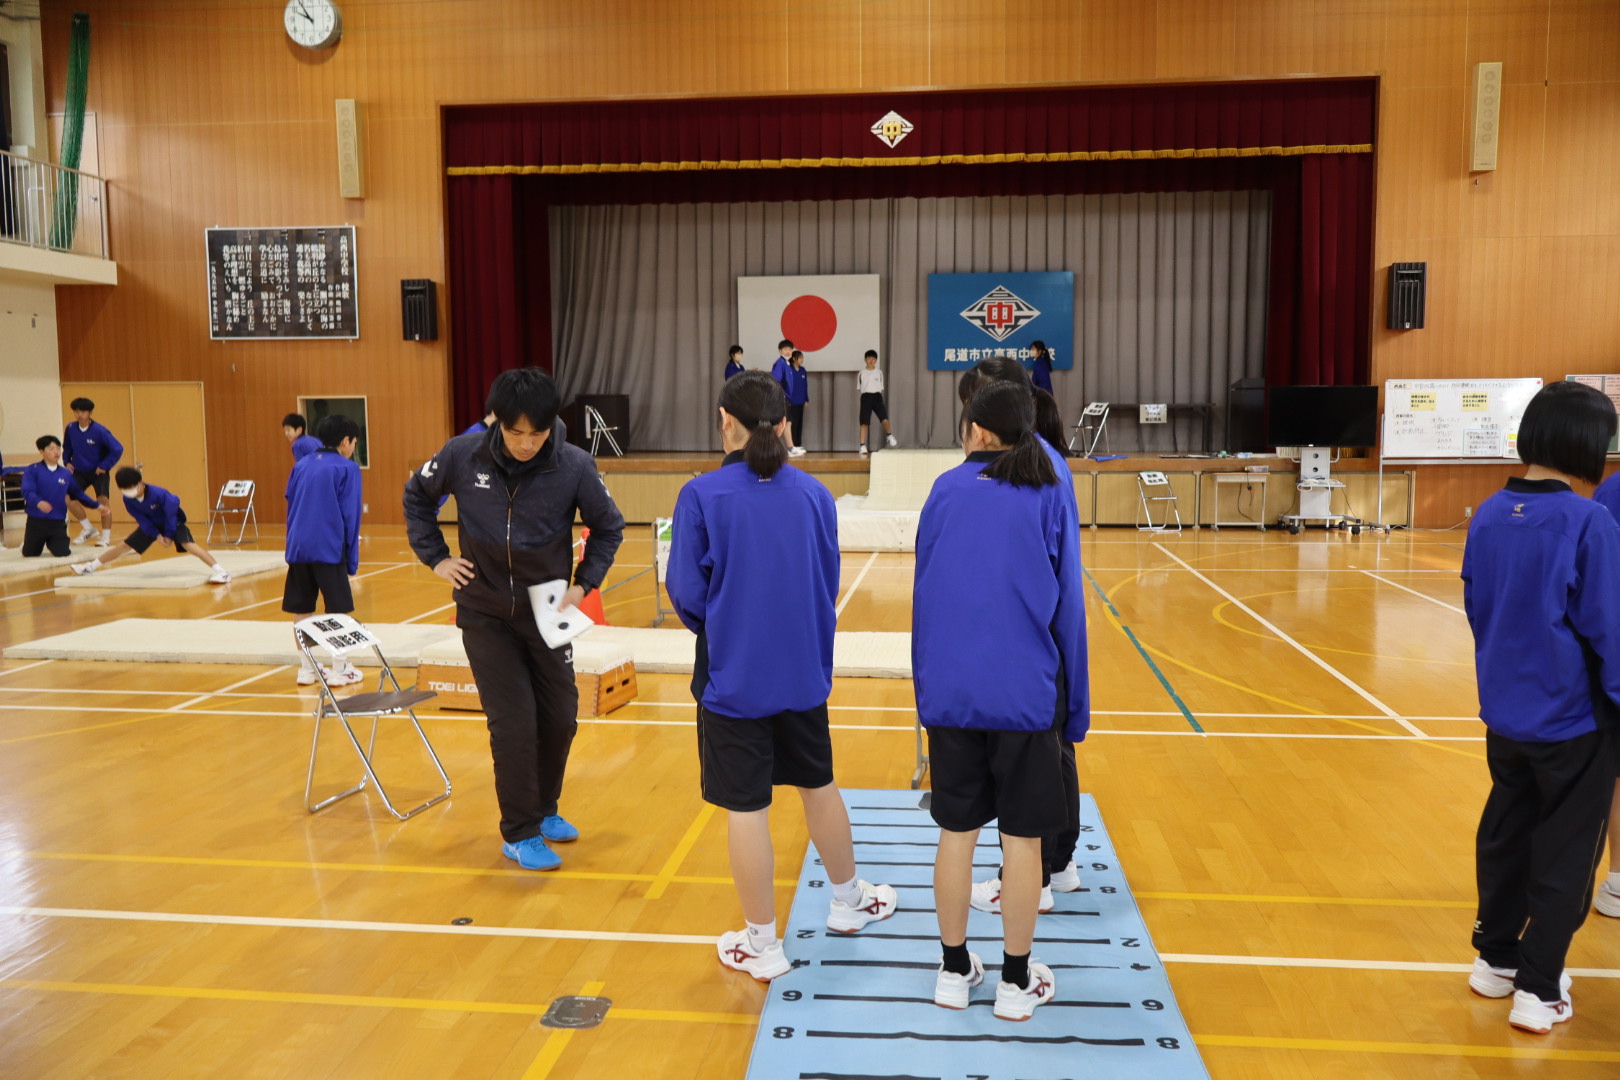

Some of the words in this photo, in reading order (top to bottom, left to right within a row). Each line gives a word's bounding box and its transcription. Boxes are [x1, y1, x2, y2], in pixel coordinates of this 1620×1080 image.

[882, 121, 902, 140] 中
[986, 301, 1014, 329] 中
[428, 681, 455, 692] TOEI
[808, 880, 825, 888] 8
[1099, 886, 1117, 894] 8
[773, 1026, 795, 1039] 8
[1156, 1037, 1181, 1050] 8
